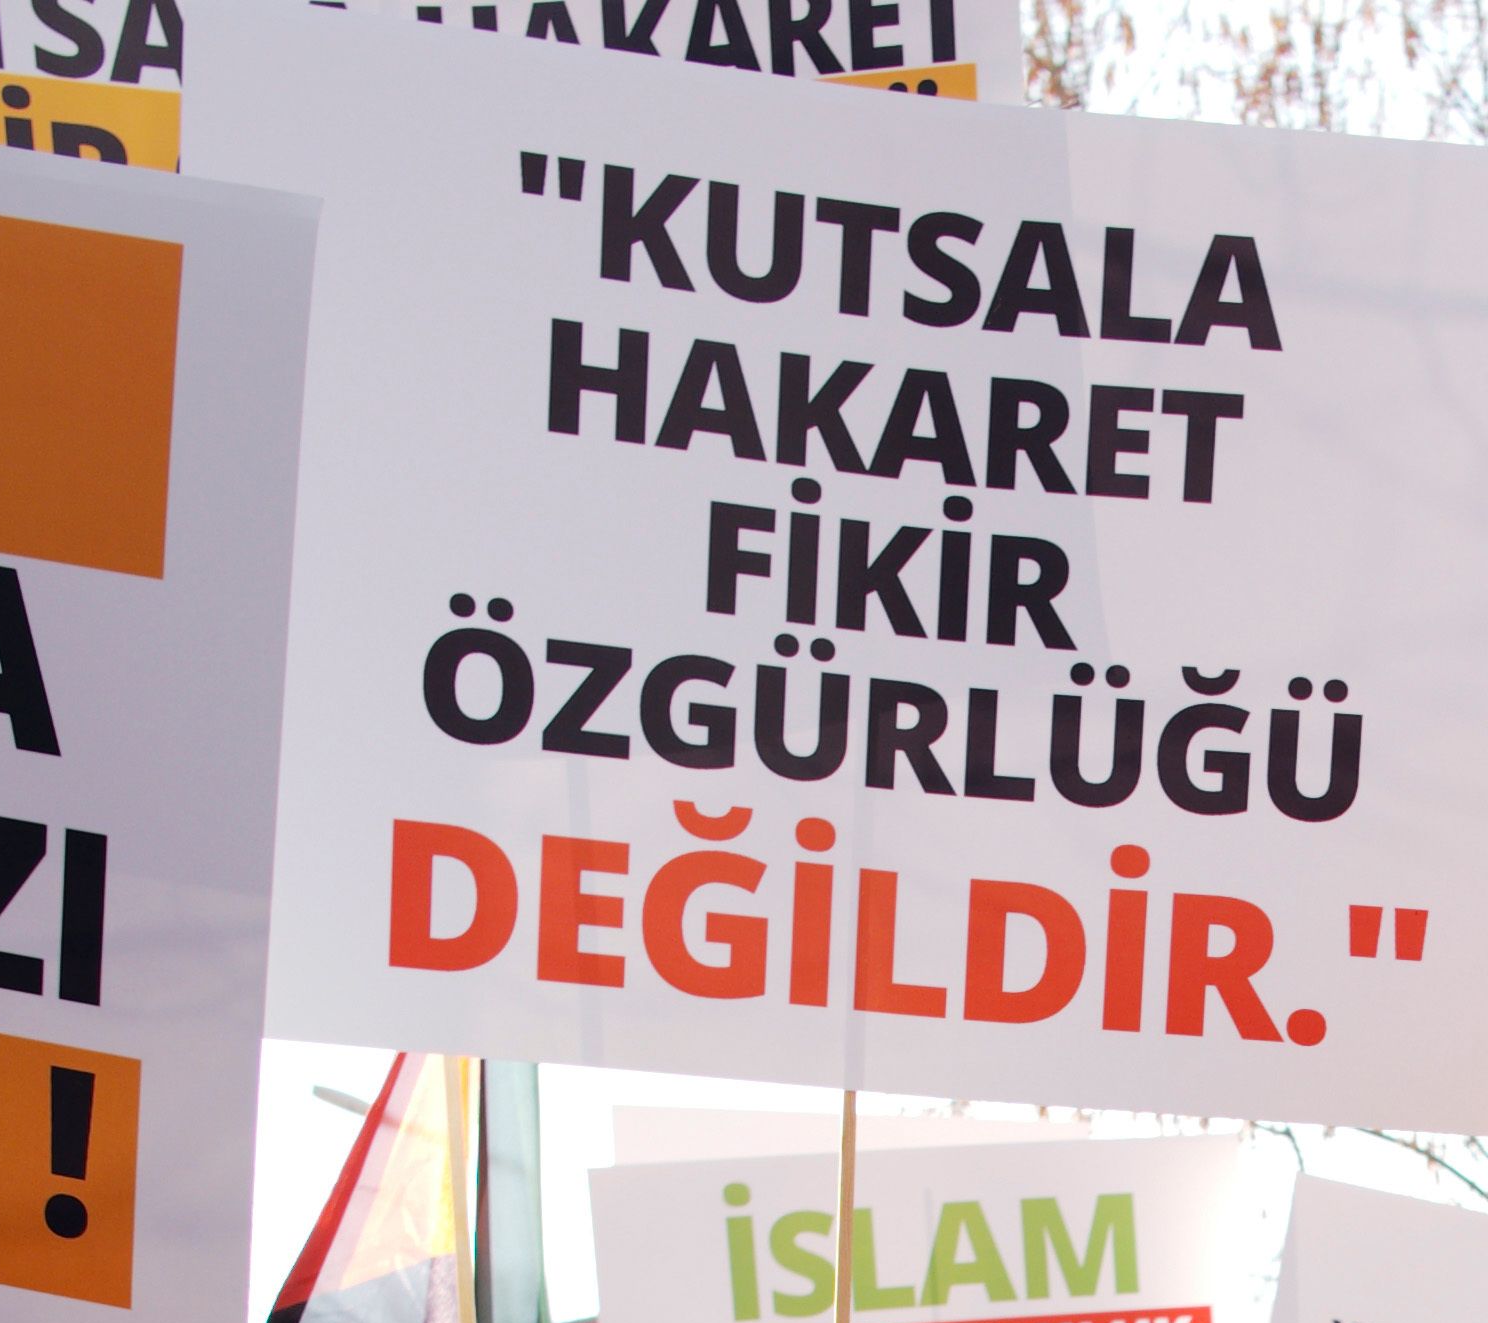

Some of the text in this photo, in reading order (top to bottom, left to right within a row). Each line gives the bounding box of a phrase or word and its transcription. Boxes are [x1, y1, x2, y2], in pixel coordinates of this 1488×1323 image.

[519, 150, 1283, 352] "KUTSALA
[546, 316, 1244, 504] HAKARET
[705, 476, 1077, 650] FİKİR
[423, 592, 1364, 823] ÖZGÜRLÜĞÜ
[387, 799, 1429, 1047] DEĞİLDİR."
[722, 1182, 1140, 1322] İSLAM
